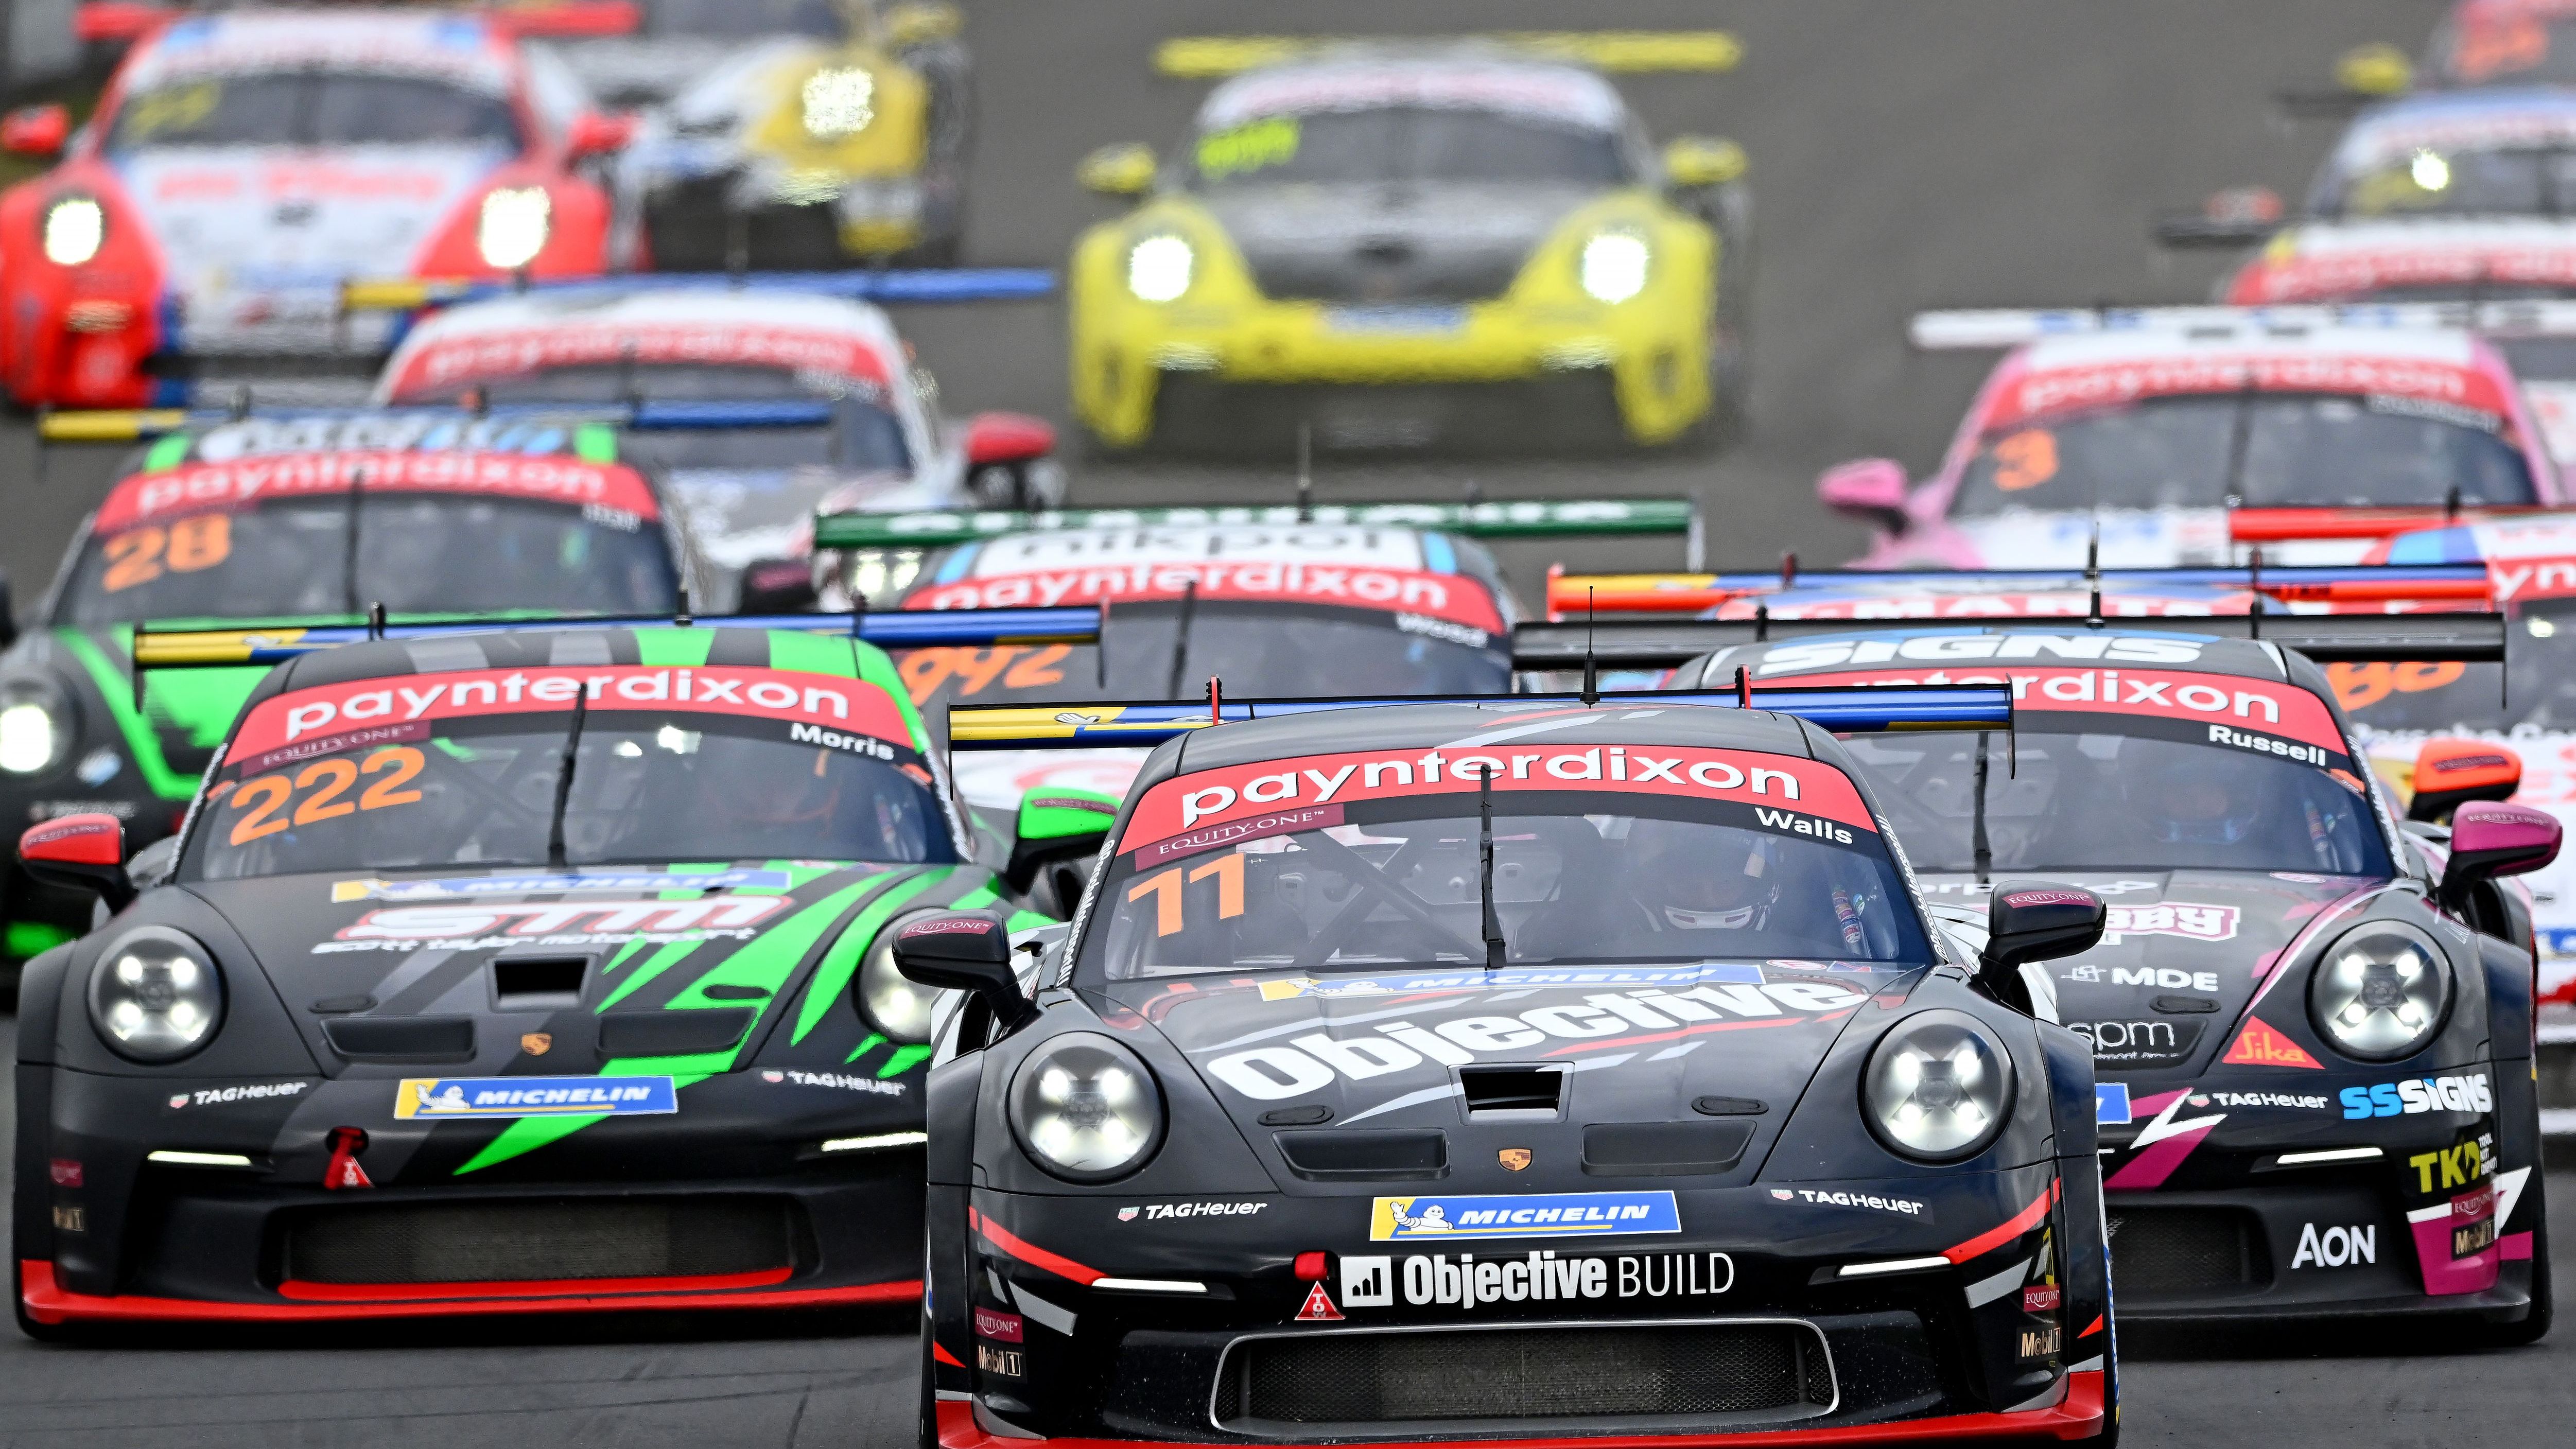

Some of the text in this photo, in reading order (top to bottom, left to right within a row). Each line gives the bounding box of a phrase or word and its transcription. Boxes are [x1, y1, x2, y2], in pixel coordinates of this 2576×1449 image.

[1993, 430, 2057, 491] 3
[137, 453, 605, 516] paynterdixon
[102, 514, 232, 593] 28
[1759, 635, 2204, 675] SIGNS
[286, 669, 848, 741] paynterdixon
[791, 722, 894, 761] Morris
[2209, 725, 2326, 766] Russell
[230, 747, 425, 846] 222
[1183, 747, 1800, 829] paynterdixon
[1754, 808, 1853, 845] Walls
[1129, 852, 1244, 938] 11
[1400, 968, 1716, 990] MICHELIN
[2112, 968, 2218, 991] MDE
[1207, 981, 1870, 1101] Objective
[2235, 1032, 2306, 1064] Sika
[475, 1085, 651, 1106] MICHELIN
[1458, 1206, 1650, 1224] MICHELIN
[2291, 1223, 2375, 1269] AON
[1404, 1251, 1735, 1308] Objective BUILD
[979, 1345, 1005, 1375] Mobil
